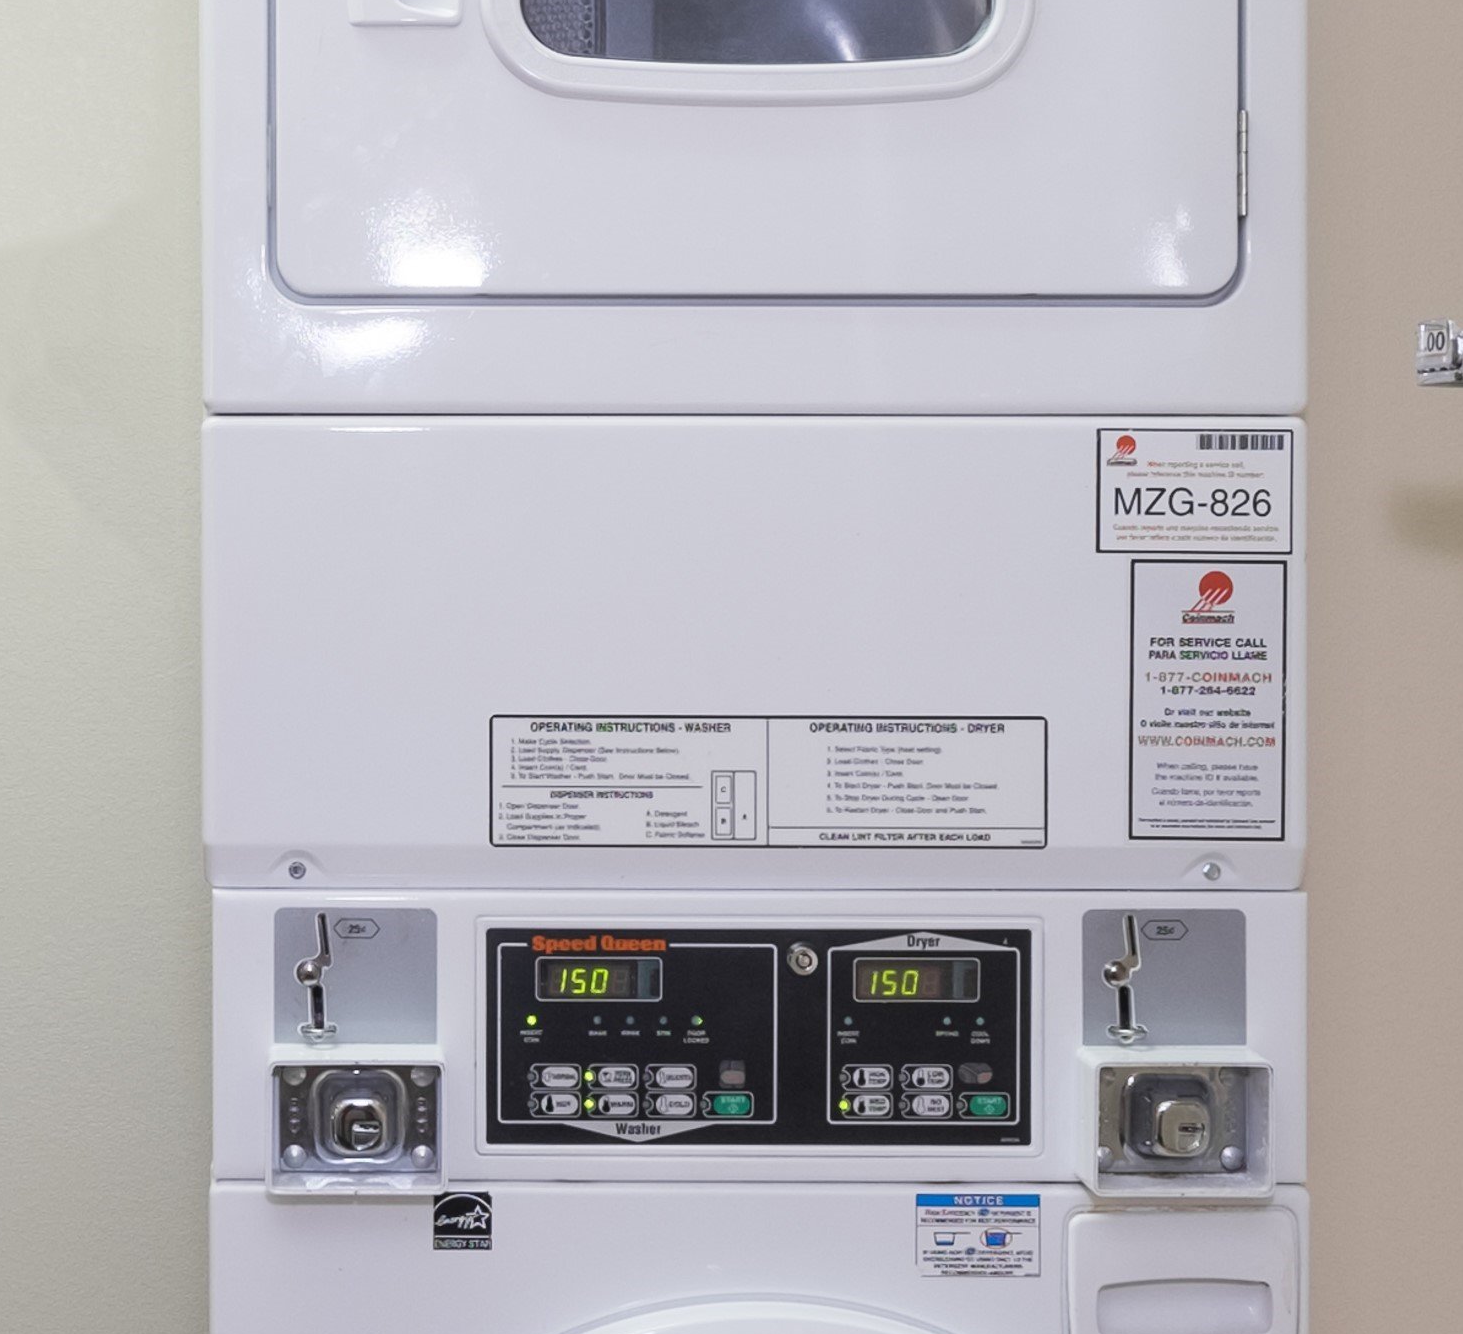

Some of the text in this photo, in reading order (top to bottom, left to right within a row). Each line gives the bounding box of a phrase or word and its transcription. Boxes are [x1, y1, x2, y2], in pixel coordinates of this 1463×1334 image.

[1113, 486, 1272, 517] MZG-826
[1149, 637, 1267, 648] FOR SERVICE CALL
[1148, 650, 1268, 661] PARA SERVICIO LLAME
[1145, 671, 1272, 684] 1-877-COINMACH
[530, 722, 731, 733] OPERATING INSTRUCTIONS WASHER
[809, 722, 1005, 734] OPERATING INSTRUCTIONS DRYER
[1137, 735, 1276, 747] WWW.COINMACH.COM
[596, 790, 654, 799] INSTRUCTIONS
[819, 833, 991, 842] CLEAN LINT FILTER AFTER EACH LOAD
[532, 935, 667, 955] Speed Queen
[906, 935, 941, 951] Dryer
[560, 967, 610, 995] 150
[869, 969, 919, 996] 150
[668, 1100, 691, 1108] COLD
[720, 1095, 746, 1103] START
[615, 1123, 663, 1137] Washer
[954, 1196, 1005, 1206] NOTICE
[434, 1238, 492, 1249] ENERGY STAR
